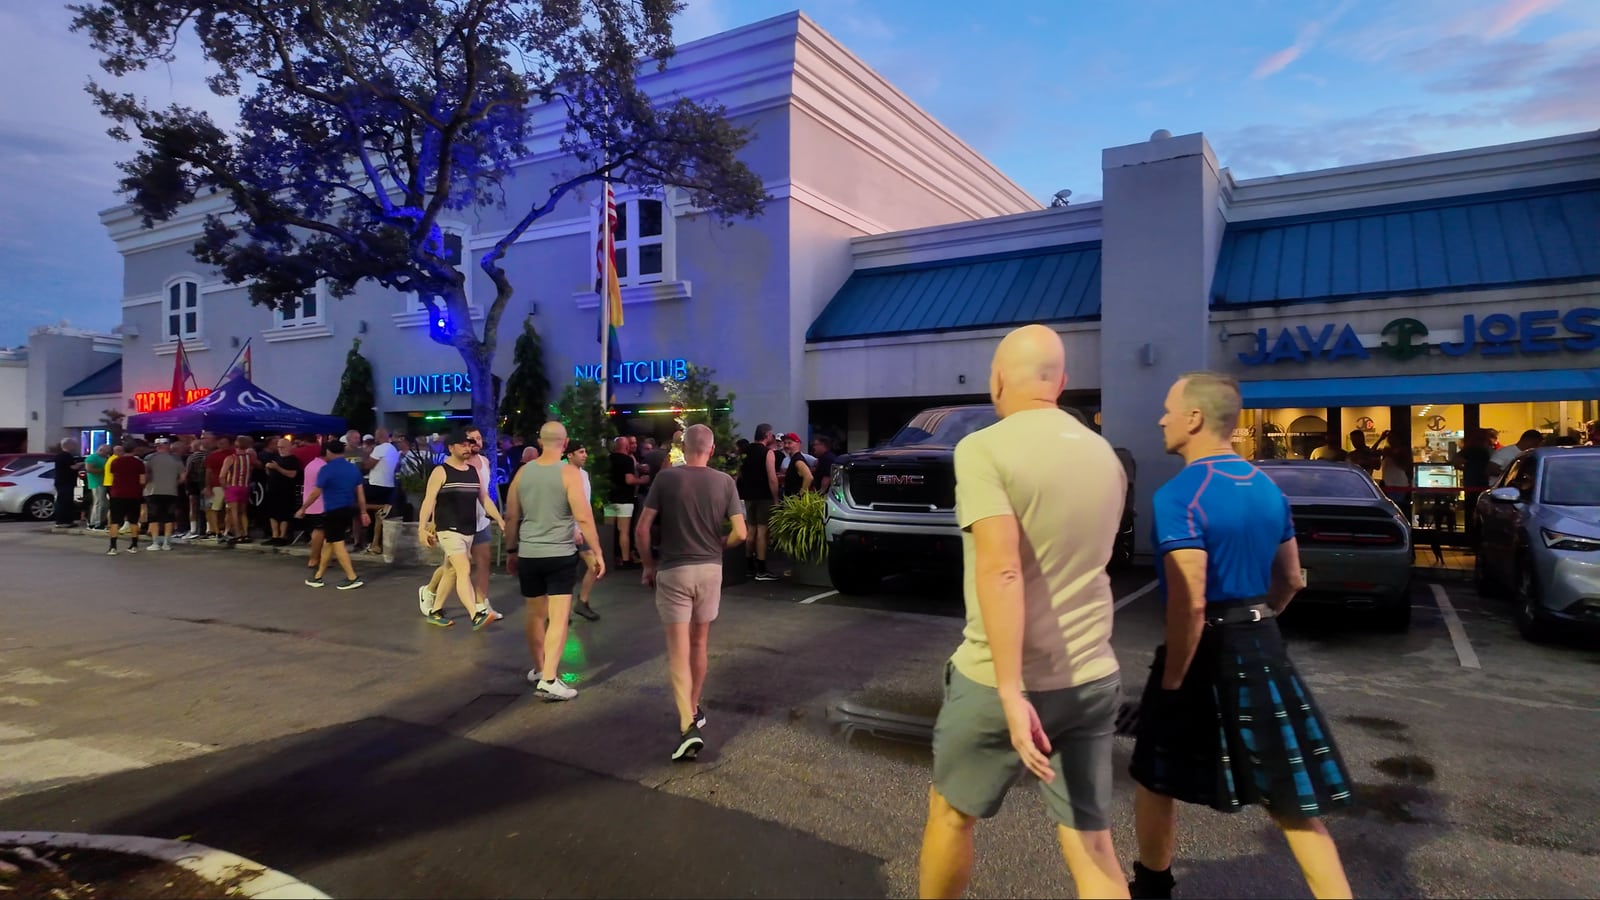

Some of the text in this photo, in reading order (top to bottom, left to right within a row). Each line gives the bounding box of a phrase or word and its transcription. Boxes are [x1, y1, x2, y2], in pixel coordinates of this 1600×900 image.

[1237, 307, 1600, 366] JAVA JOES
[394, 373, 472, 395] HUNTERS
[136, 393, 156, 413] TAP
[877, 474, 924, 485] GMC
